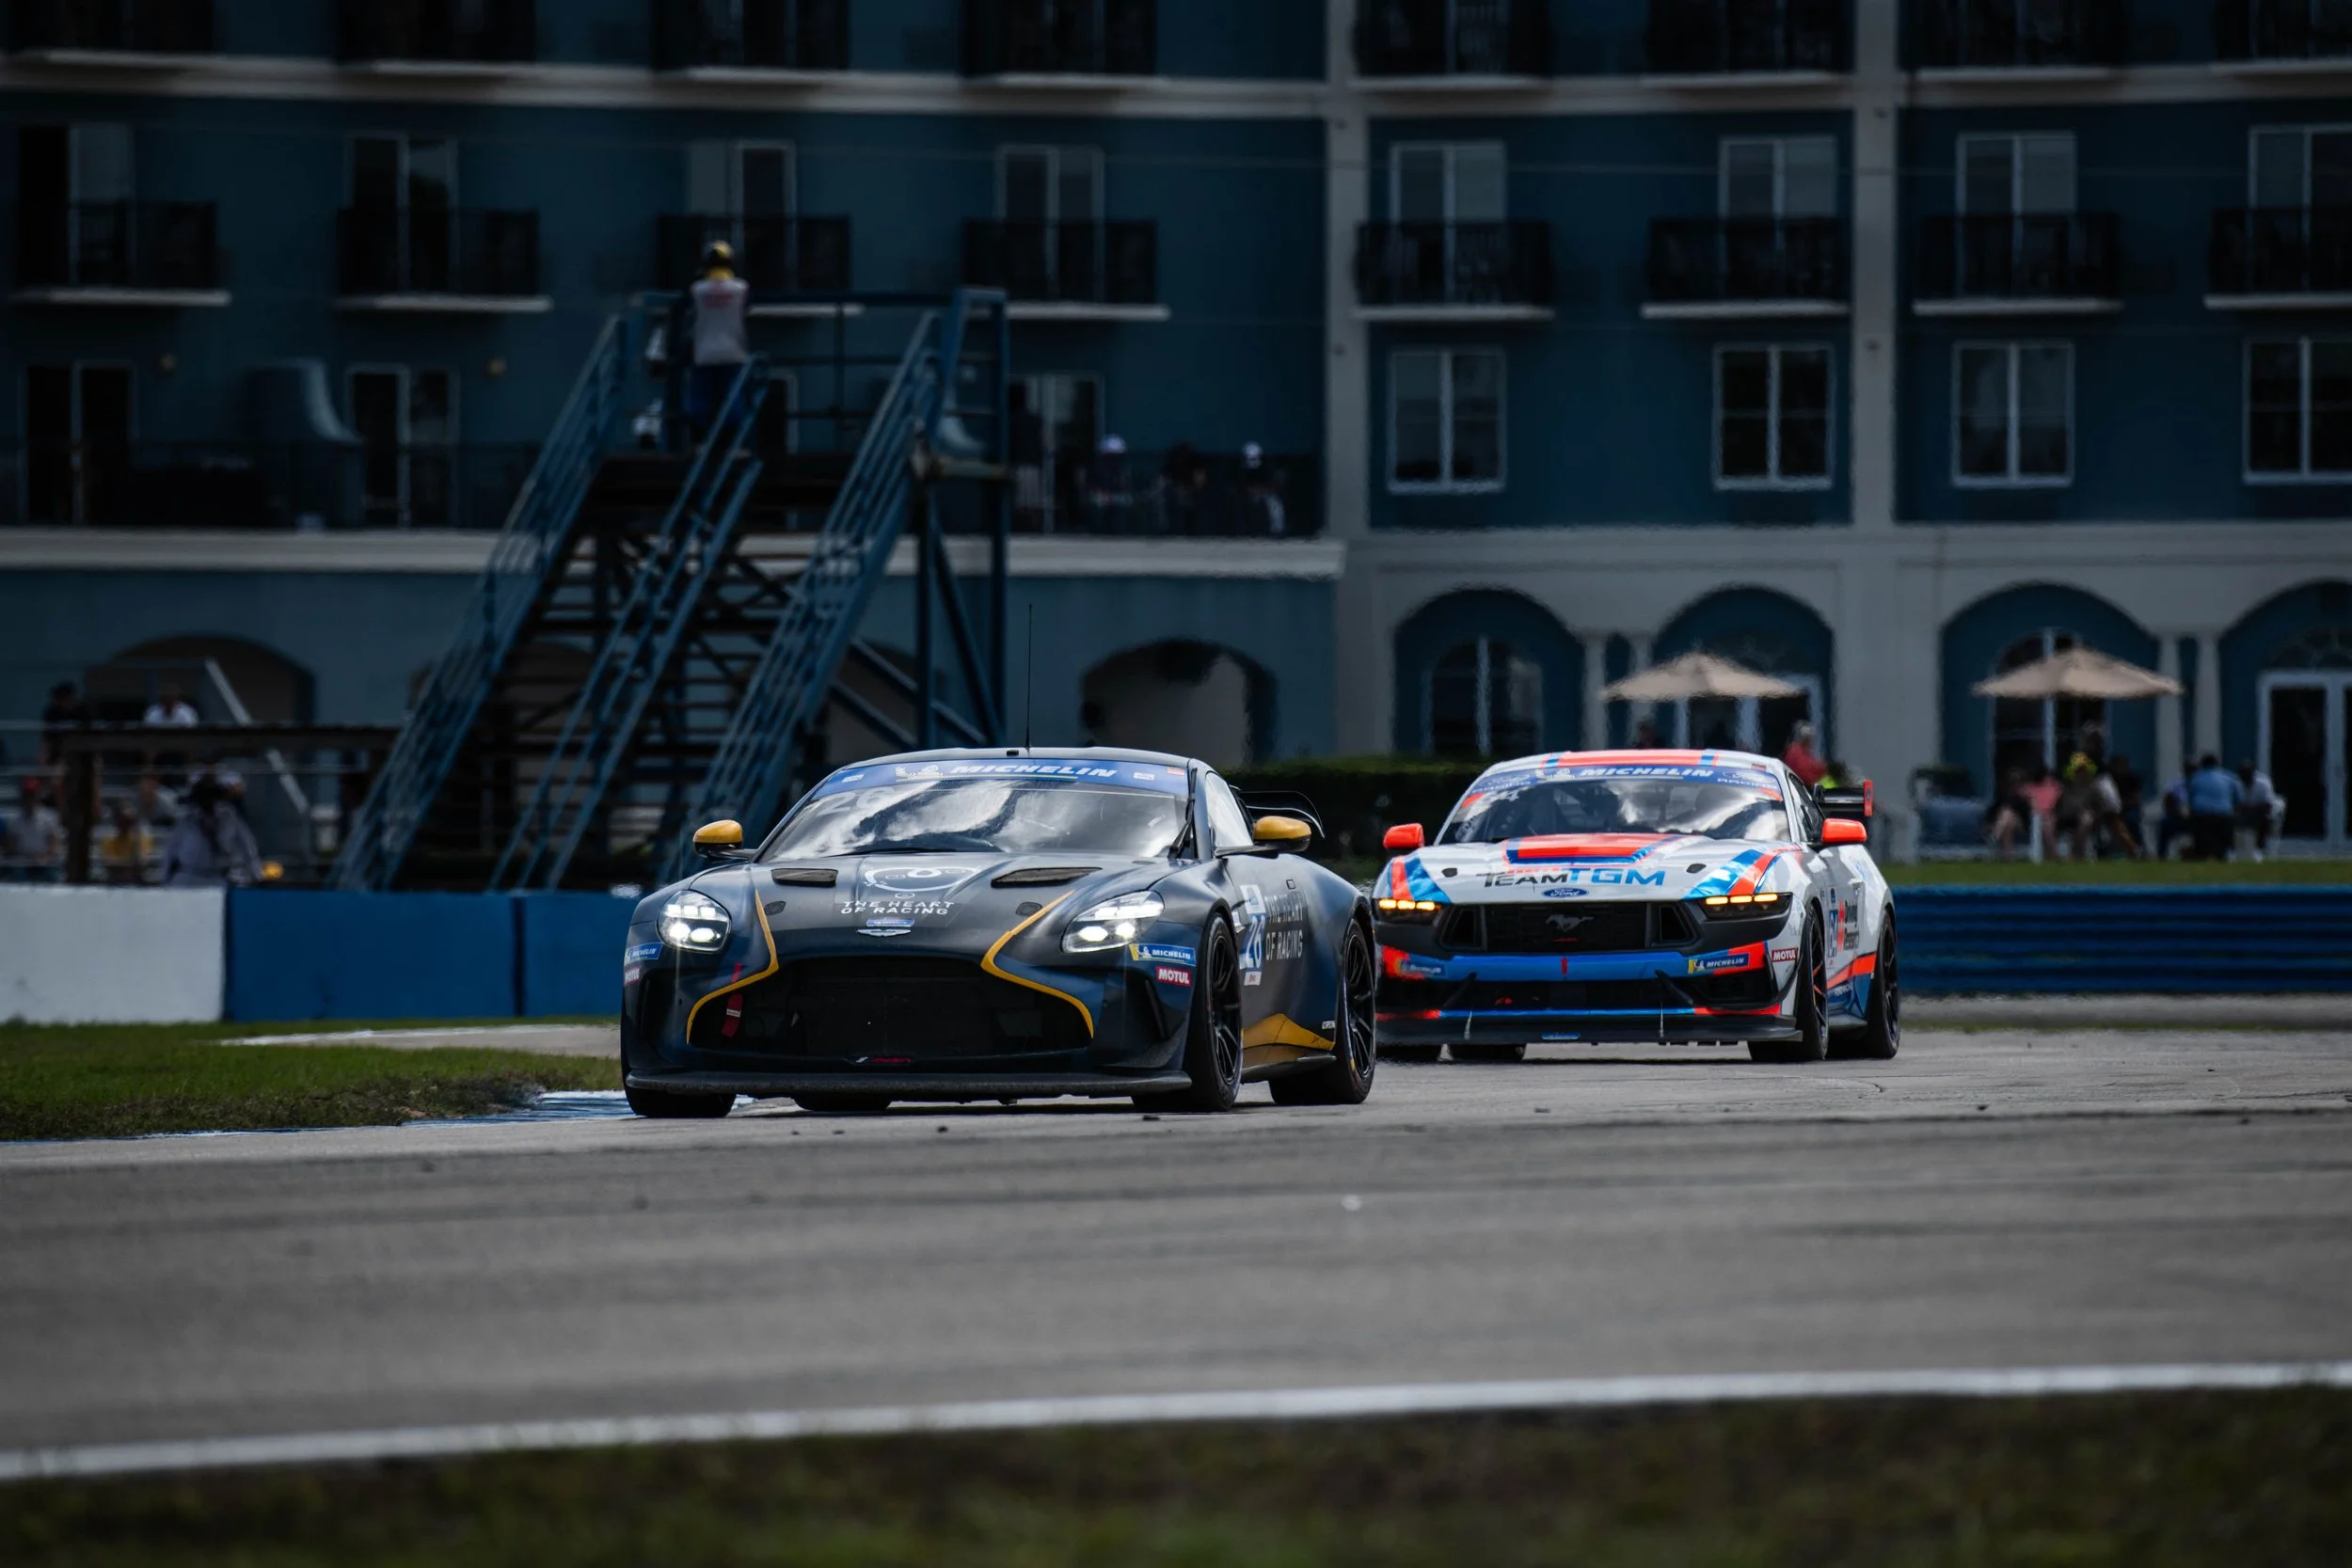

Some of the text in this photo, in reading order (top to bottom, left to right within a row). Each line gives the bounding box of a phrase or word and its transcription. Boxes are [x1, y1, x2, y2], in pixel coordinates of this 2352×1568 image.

[949, 763, 1118, 779] MICHELIN
[1581, 767, 1713, 778] MICHELIN
[816, 786, 896, 817] 26
[1549, 888, 1581, 897] Ford
[842, 900, 955, 909] THE HEART
[840, 907, 948, 915] OF RACING
[1246, 914, 1266, 969] 26
[1265, 929, 1303, 961] OF RACING
[1152, 949, 1191, 960] MICHELIN
[1772, 948, 1797, 961] MOTUL
[1706, 957, 1745, 969] MICHELIN
[1158, 968, 1190, 984] MOTUL
